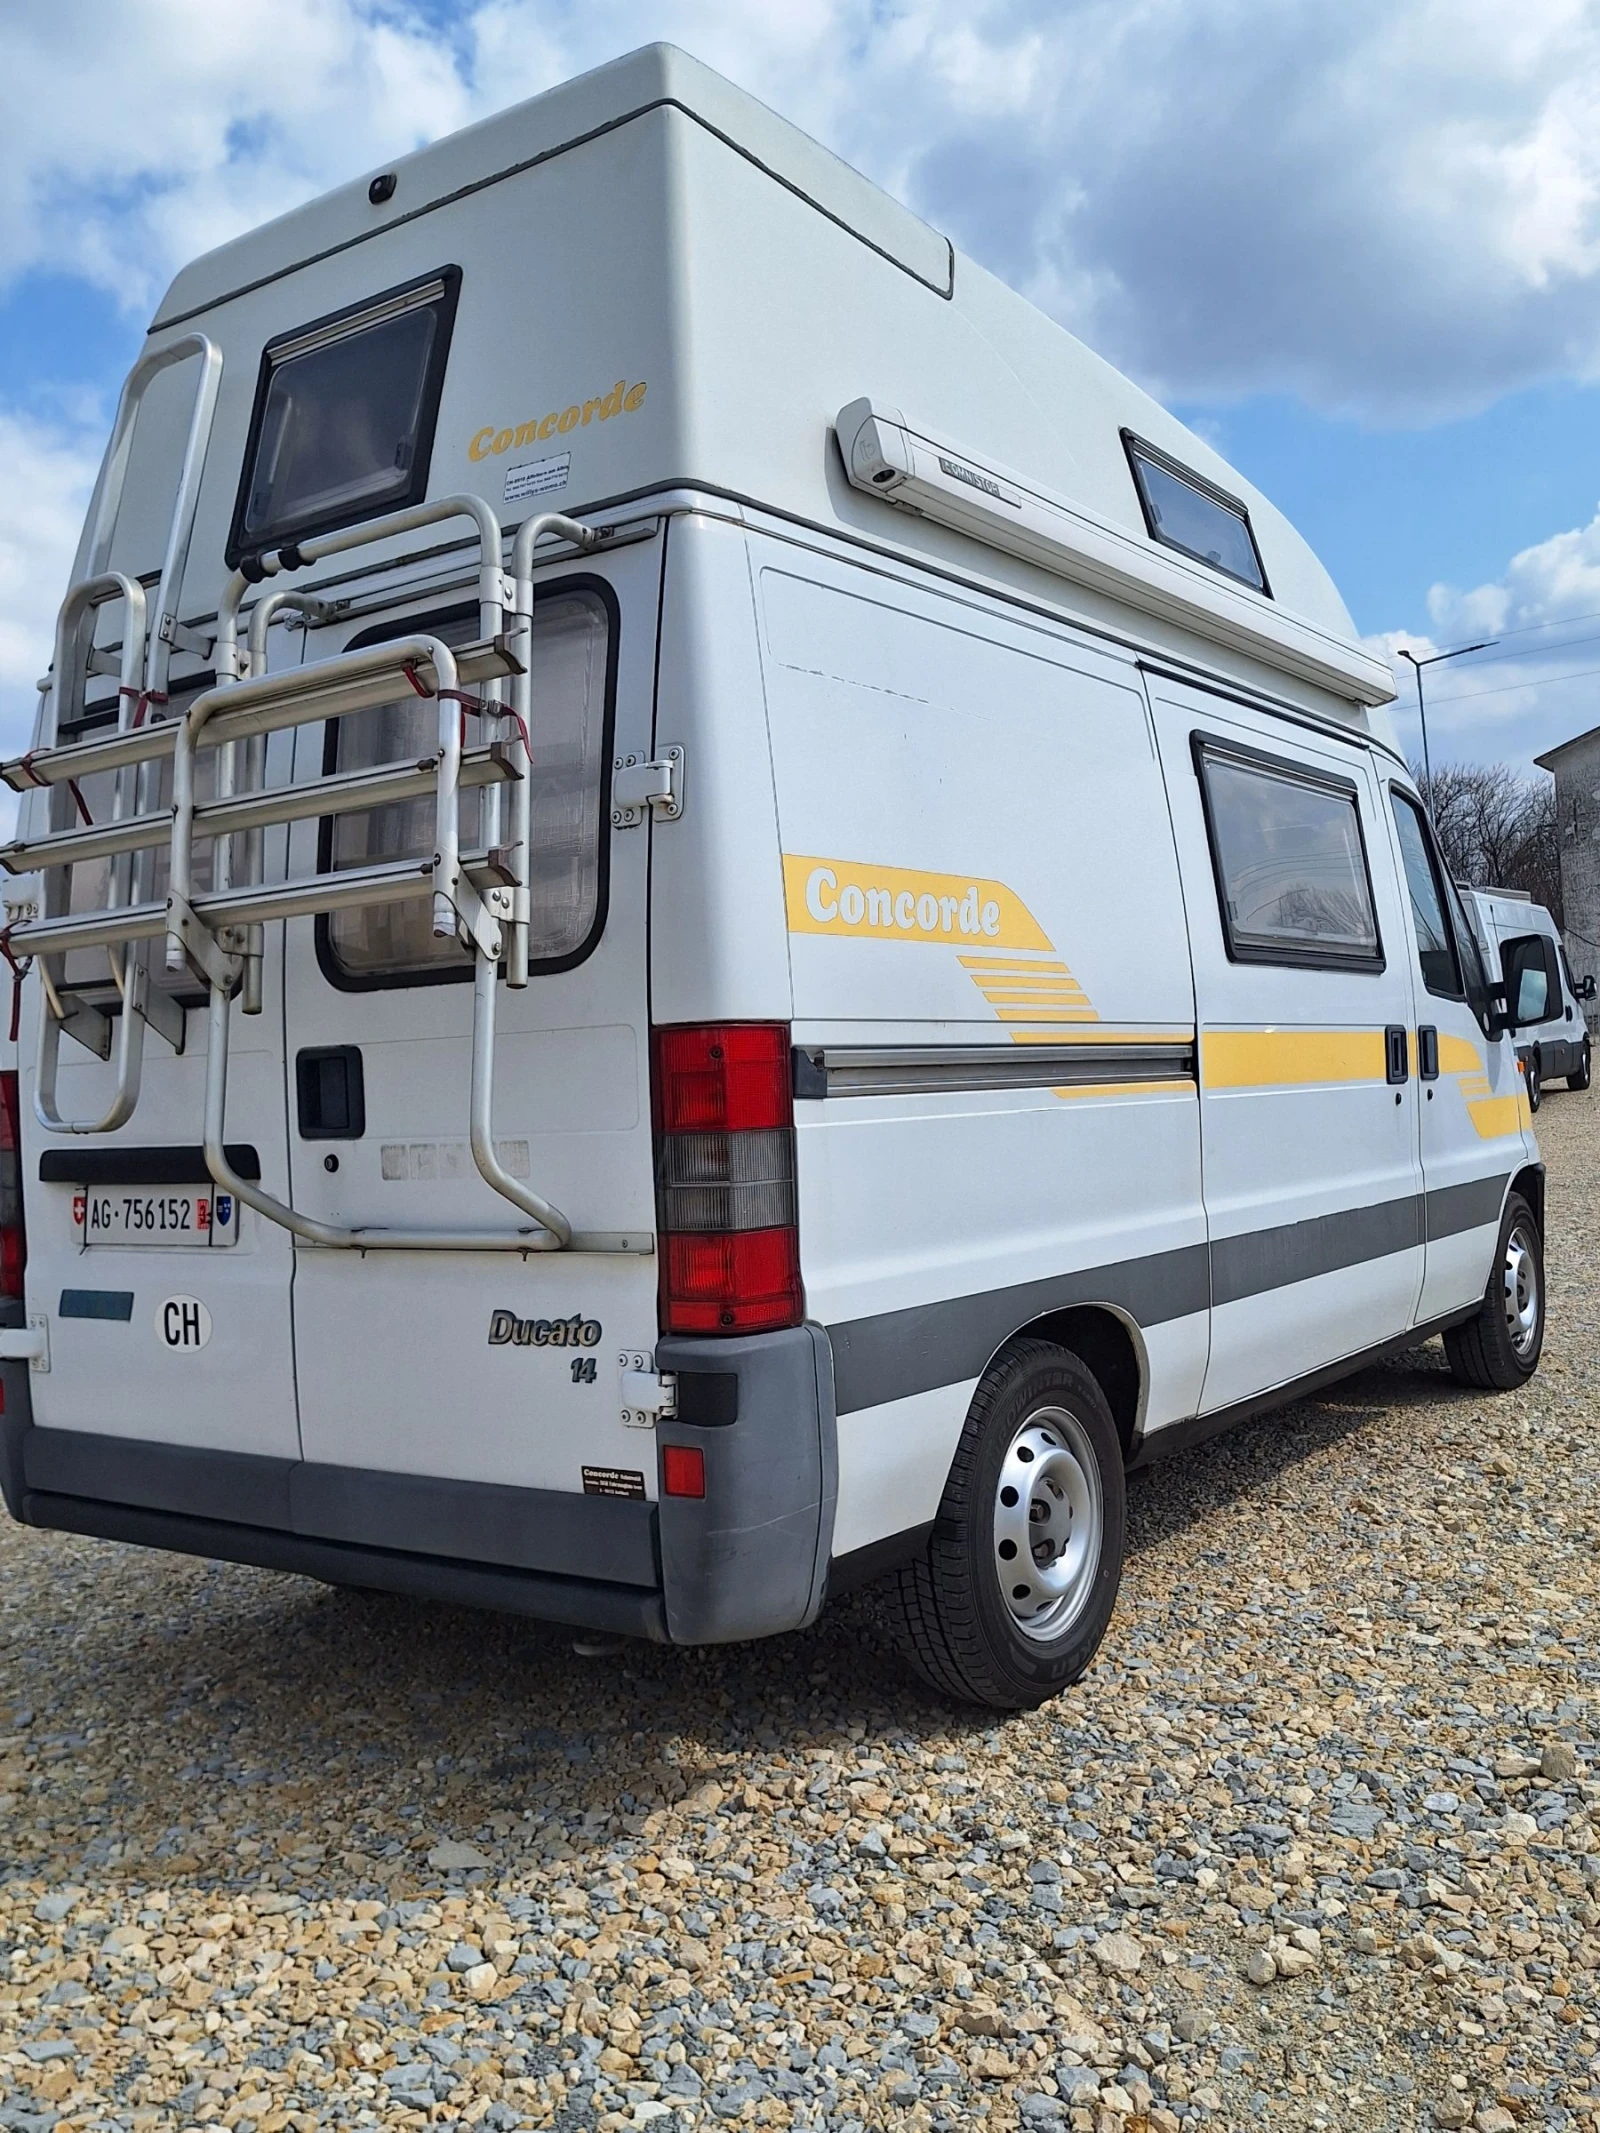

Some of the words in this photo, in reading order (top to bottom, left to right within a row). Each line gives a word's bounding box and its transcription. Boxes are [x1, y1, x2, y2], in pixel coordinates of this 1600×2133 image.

[469, 380, 647, 461] Concorde
[950, 462, 1000, 498] OMNISTOR
[805, 866, 1000, 936] Concorde
[163, 1301, 201, 1346] CH
[488, 1309, 603, 1347] Ducato
[570, 1357, 597, 1384] 14
[584, 1468, 619, 1479] Concorde
